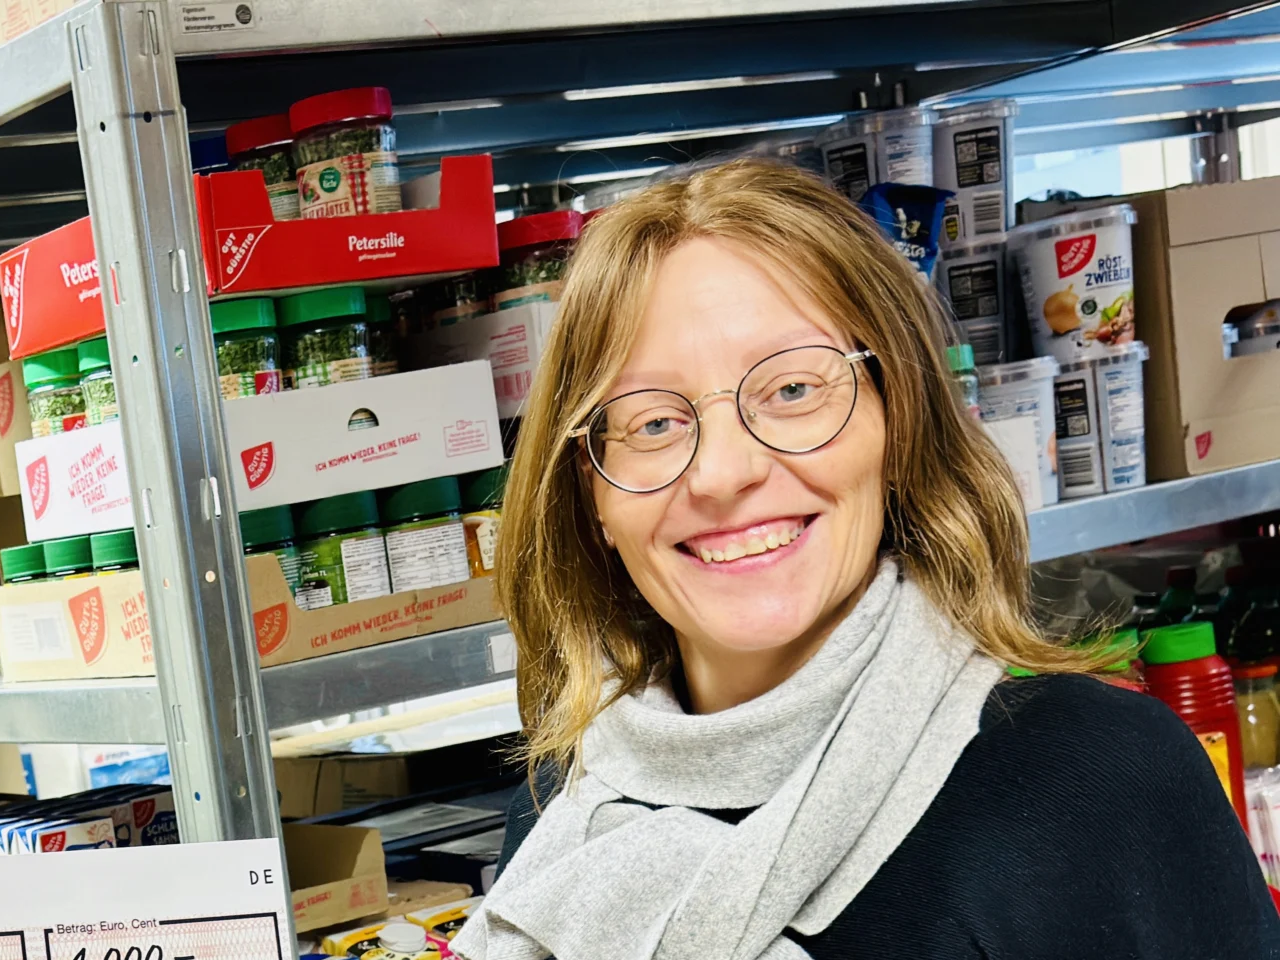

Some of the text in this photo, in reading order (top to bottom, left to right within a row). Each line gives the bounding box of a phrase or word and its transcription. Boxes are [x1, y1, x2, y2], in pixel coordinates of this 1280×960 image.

[221, 232, 236, 253] GUT
[226, 232, 255, 275] GÜNSTIG
[232, 245, 240, 253] &
[348, 232, 404, 251] Petersilie
[60, 259, 100, 287] Peters
[314, 462, 327, 472] ICH
[328, 456, 350, 469] KOMM
[378, 439, 397, 453] KEINE
[121, 596, 138, 619] ICH
[310, 635, 327, 648] ICH
[330, 624, 360, 643] KOMM
[404, 599, 435, 617] KEINE
[437, 588, 467, 608] FRAGE!
[83, 596, 98, 652] GÜNSTIG
[57, 918, 157, 935] Betrag: Euro, Cent
